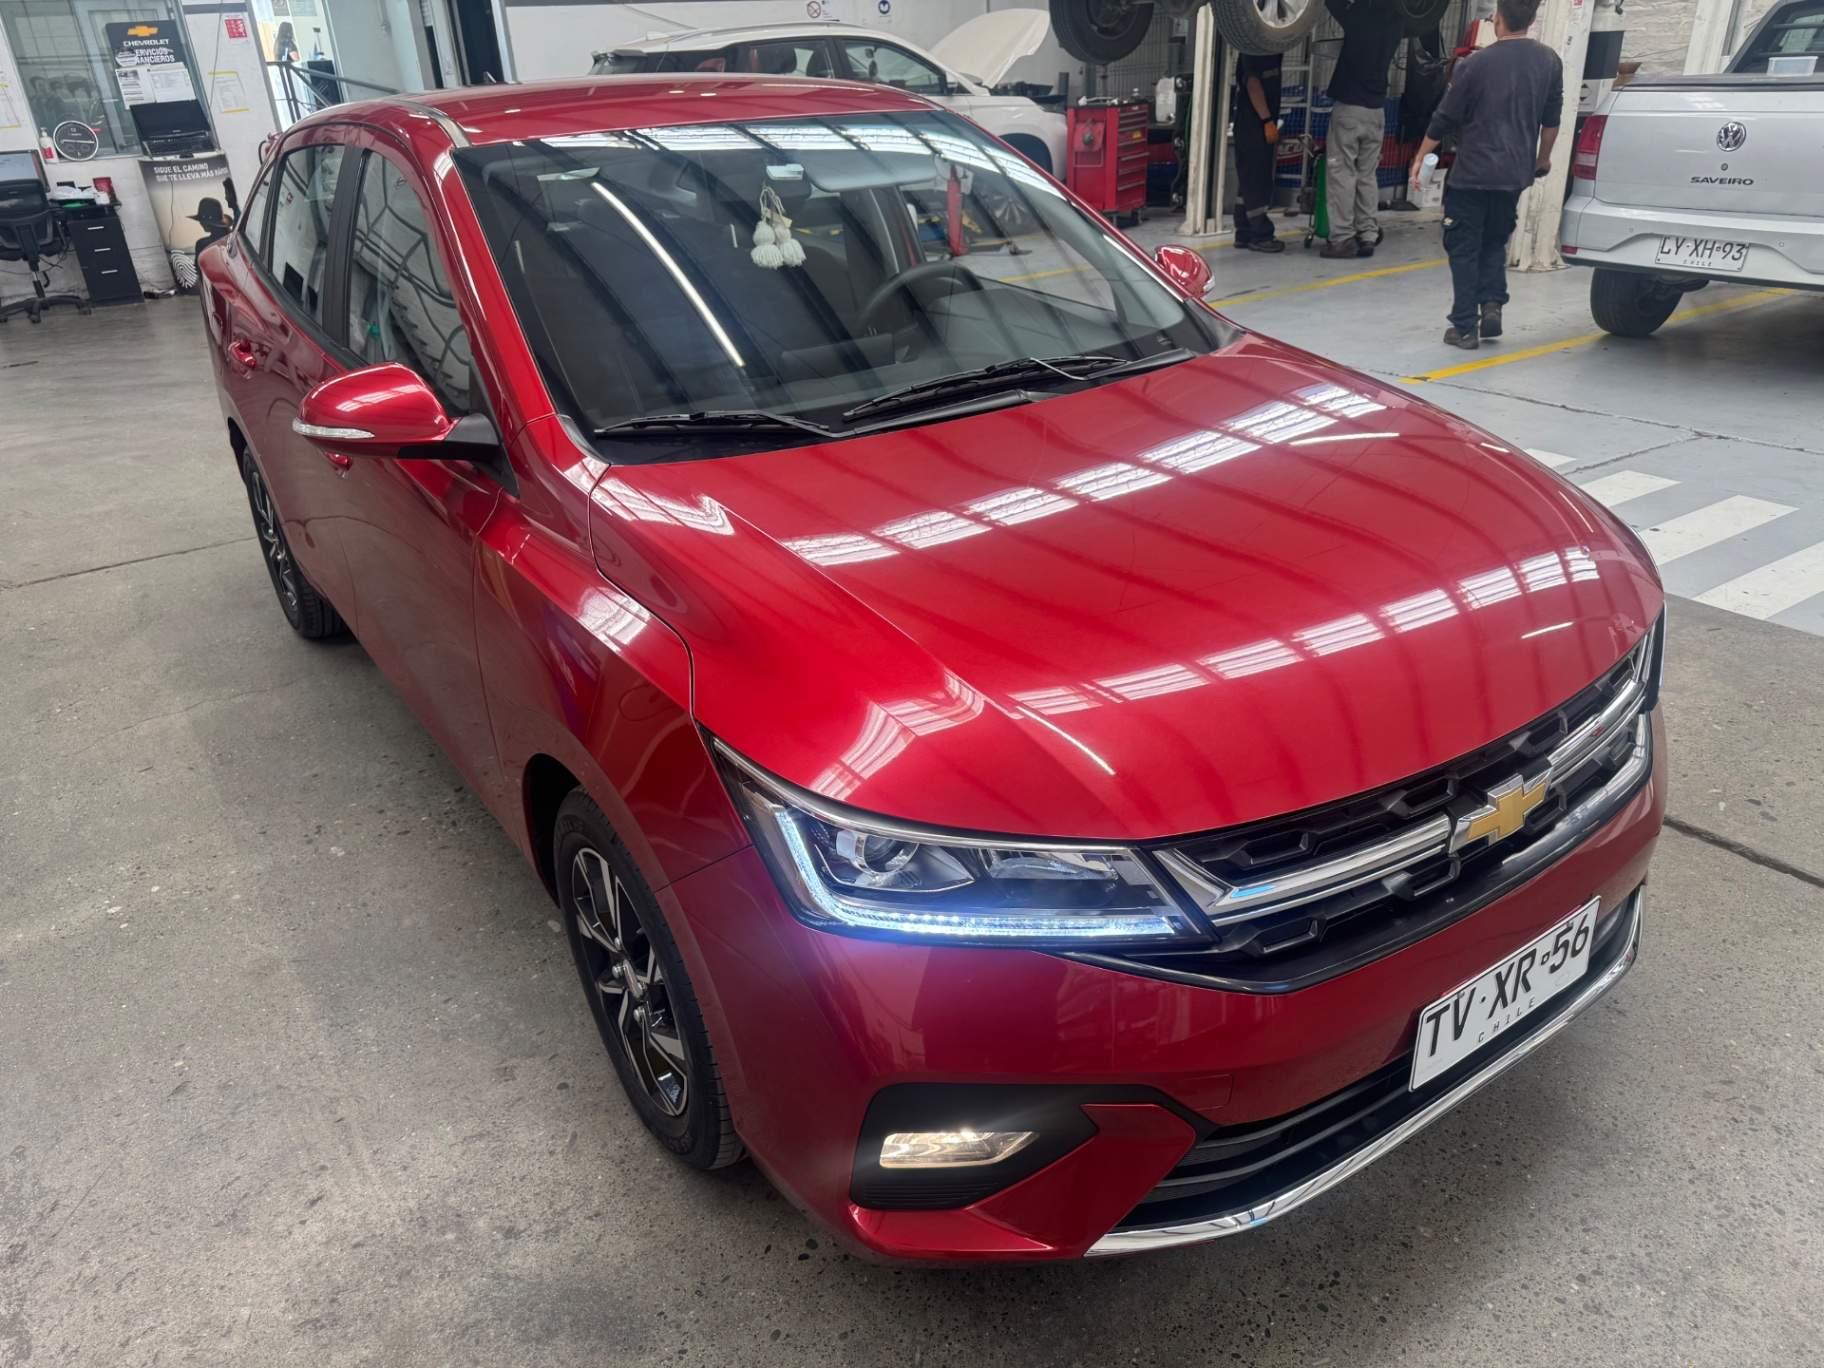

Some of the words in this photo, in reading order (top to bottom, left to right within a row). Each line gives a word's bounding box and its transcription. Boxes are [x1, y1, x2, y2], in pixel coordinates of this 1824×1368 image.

[123, 39, 169, 47] CHEVROLET
[135, 48, 169, 57] ERVICIOS
[173, 164, 182, 173] EL
[182, 162, 209, 172] CAMINO
[1690, 176, 1754, 186] SAVEIRO
[1478, 997, 1535, 1043] CHILE
